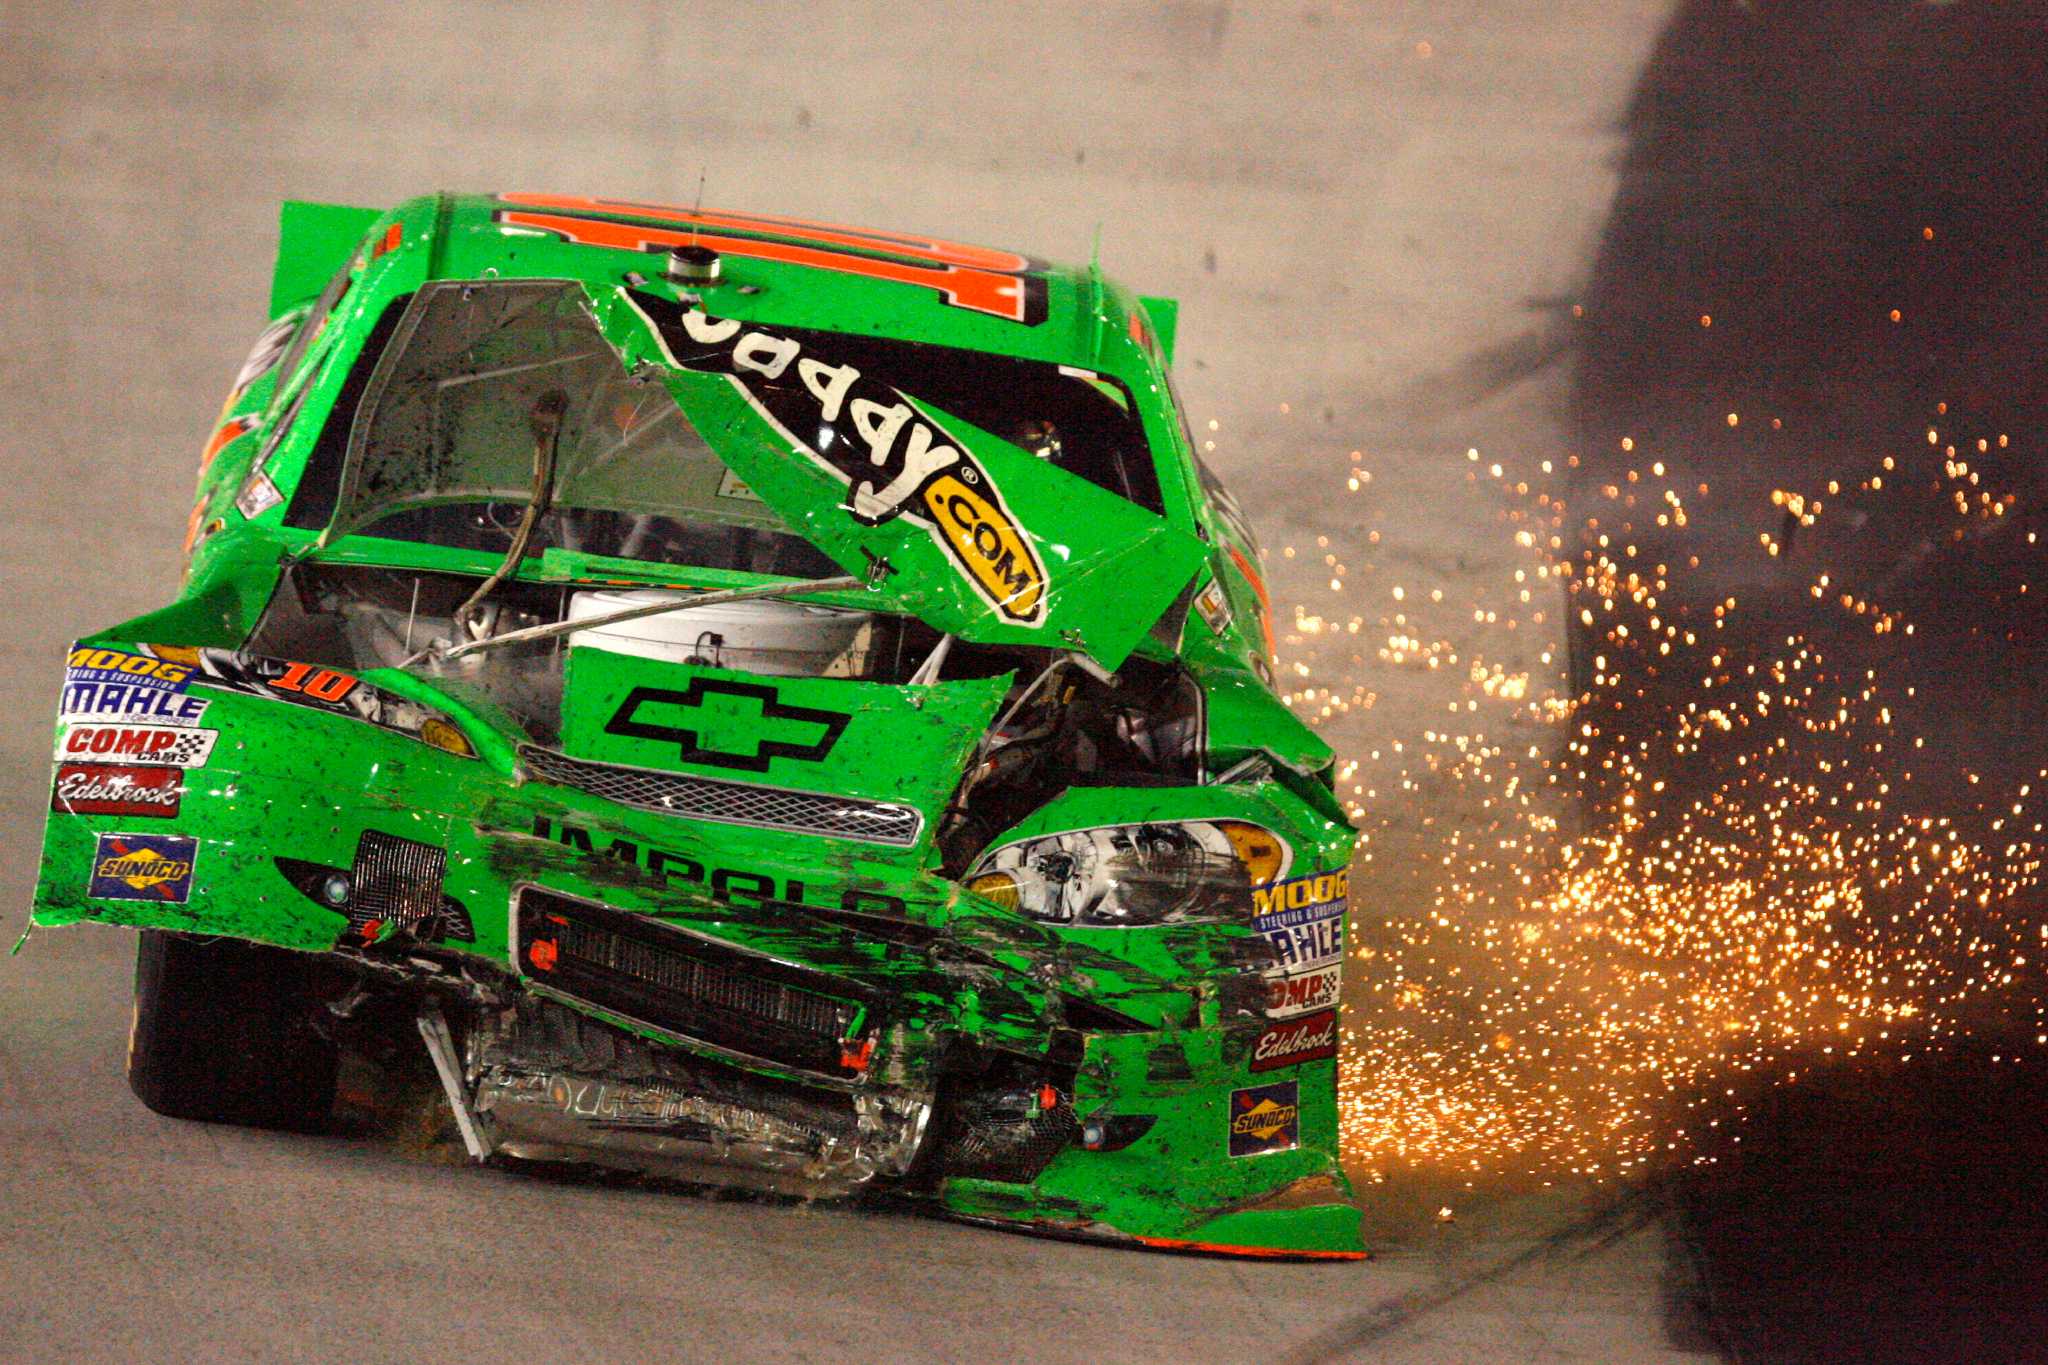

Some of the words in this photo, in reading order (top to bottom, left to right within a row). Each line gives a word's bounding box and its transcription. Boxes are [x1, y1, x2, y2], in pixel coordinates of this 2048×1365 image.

[933, 494, 1032, 601] .COM
[268, 661, 358, 702] 10
[61, 682, 208, 719] MAHLE
[66, 728, 177, 755] COMP
[135, 751, 191, 763] CAMS
[58, 772, 177, 806] Edelbrock
[101, 859, 188, 880] SUNOCO
[1253, 869, 1347, 917] MOOG
[1259, 910, 1303, 930] STEERING
[1270, 919, 1342, 966] AHLE
[1265, 975, 1323, 1010] OMP
[1302, 991, 1332, 1009] CAMS
[1255, 1020, 1334, 1061] Edelbrock
[1233, 1108, 1294, 1131] SUNOCO
